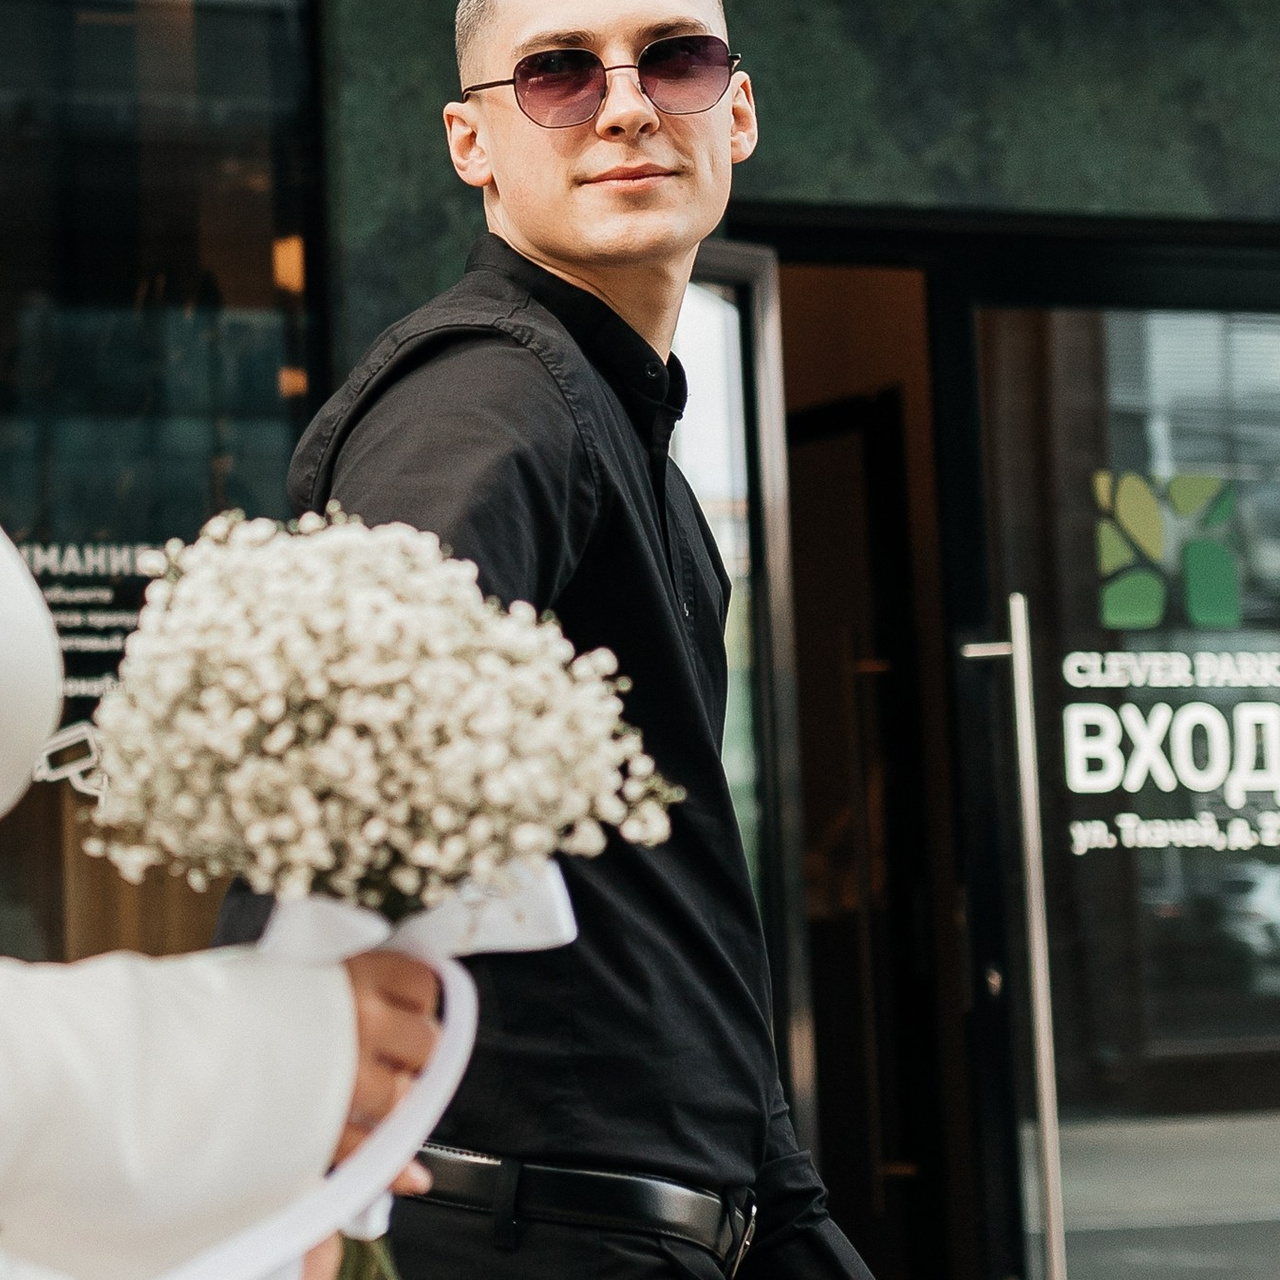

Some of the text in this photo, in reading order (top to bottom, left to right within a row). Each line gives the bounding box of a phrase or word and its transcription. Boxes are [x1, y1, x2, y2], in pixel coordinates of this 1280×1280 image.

[1062, 651, 1195, 688] CLEVER
[1062, 701, 1280, 809] ВХОД
[1070, 820, 1117, 855] ул.
